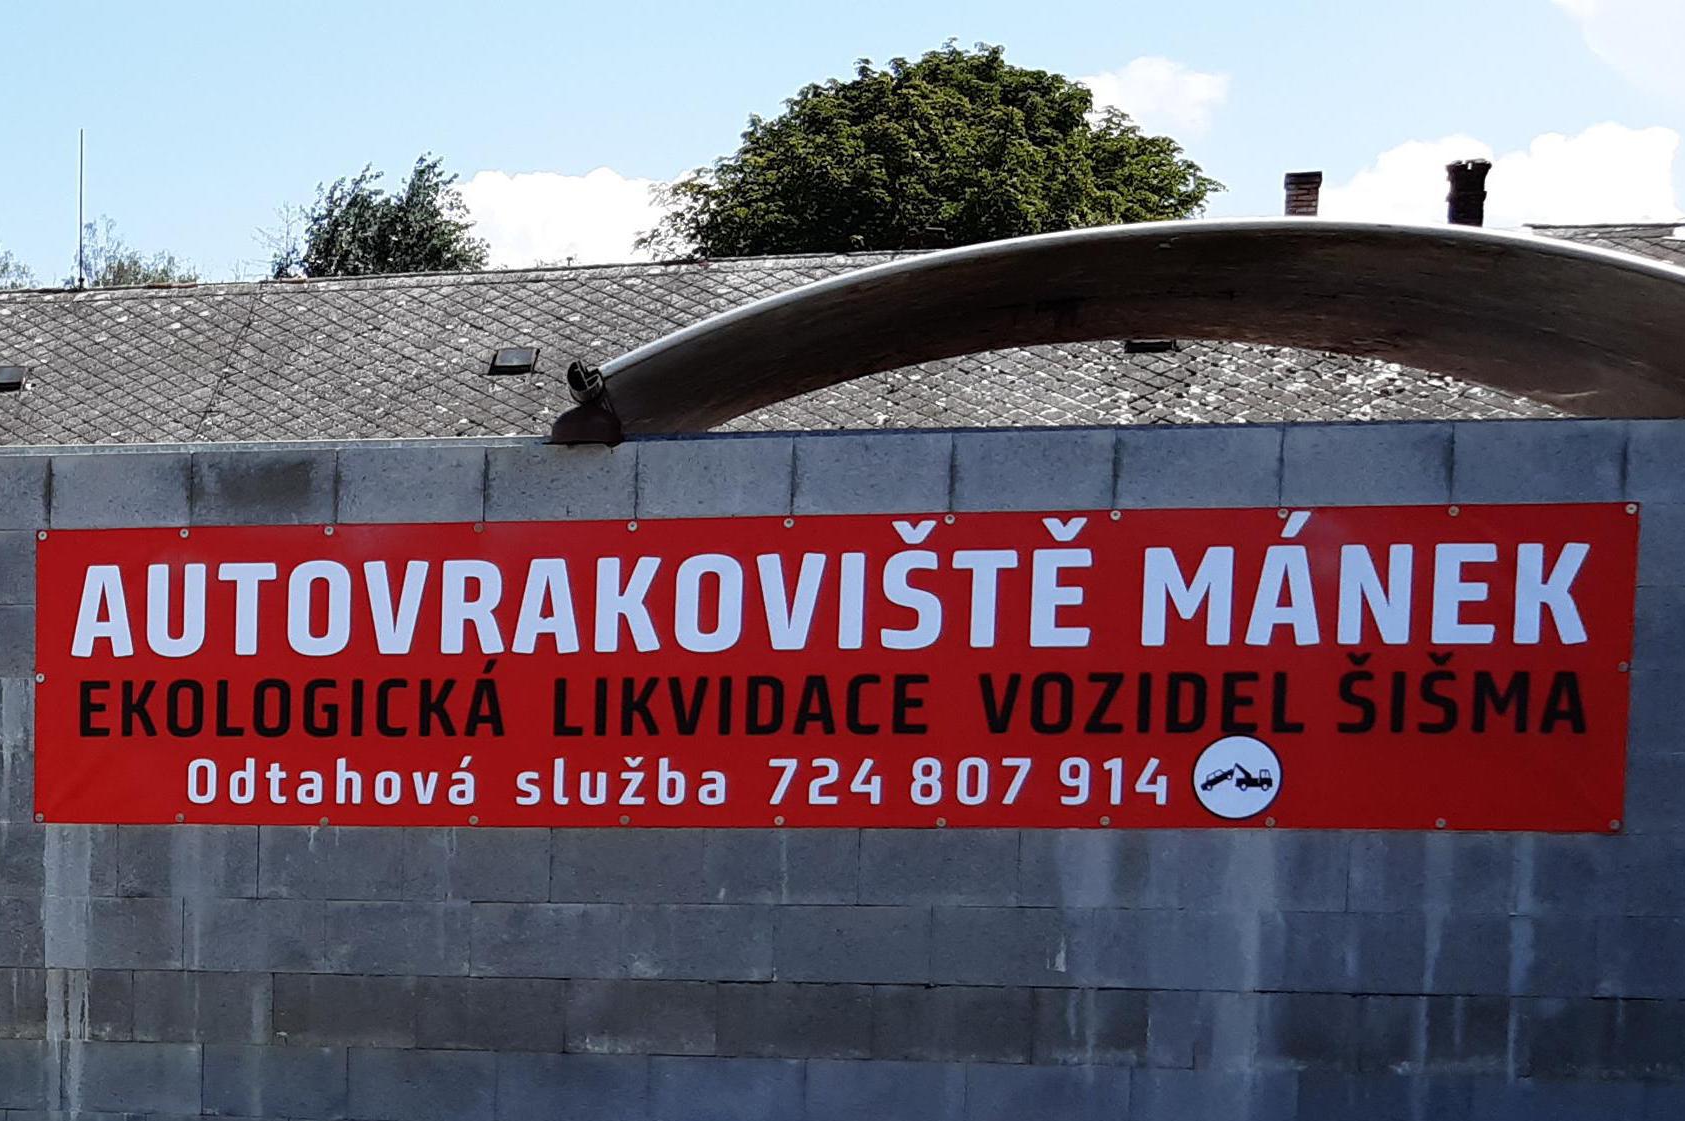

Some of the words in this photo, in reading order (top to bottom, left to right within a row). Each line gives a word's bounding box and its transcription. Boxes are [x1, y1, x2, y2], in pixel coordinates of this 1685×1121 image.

[69, 519, 1093, 658] AUTOVRAKOVIŠTĚ
[1140, 511, 1591, 649] MÁNEK
[78, 659, 506, 738] EKOLOGICKÁ
[552, 673, 931, 737] LIKVIDACE
[978, 671, 1306, 735] VOZIDEL
[1335, 651, 1587, 734] ŠIŠMA
[186, 755, 476, 806] Odtahová
[514, 756, 727, 807] služba
[767, 757, 883, 805] 724
[911, 756, 1033, 805] 807
[1059, 756, 1169, 805] 914
